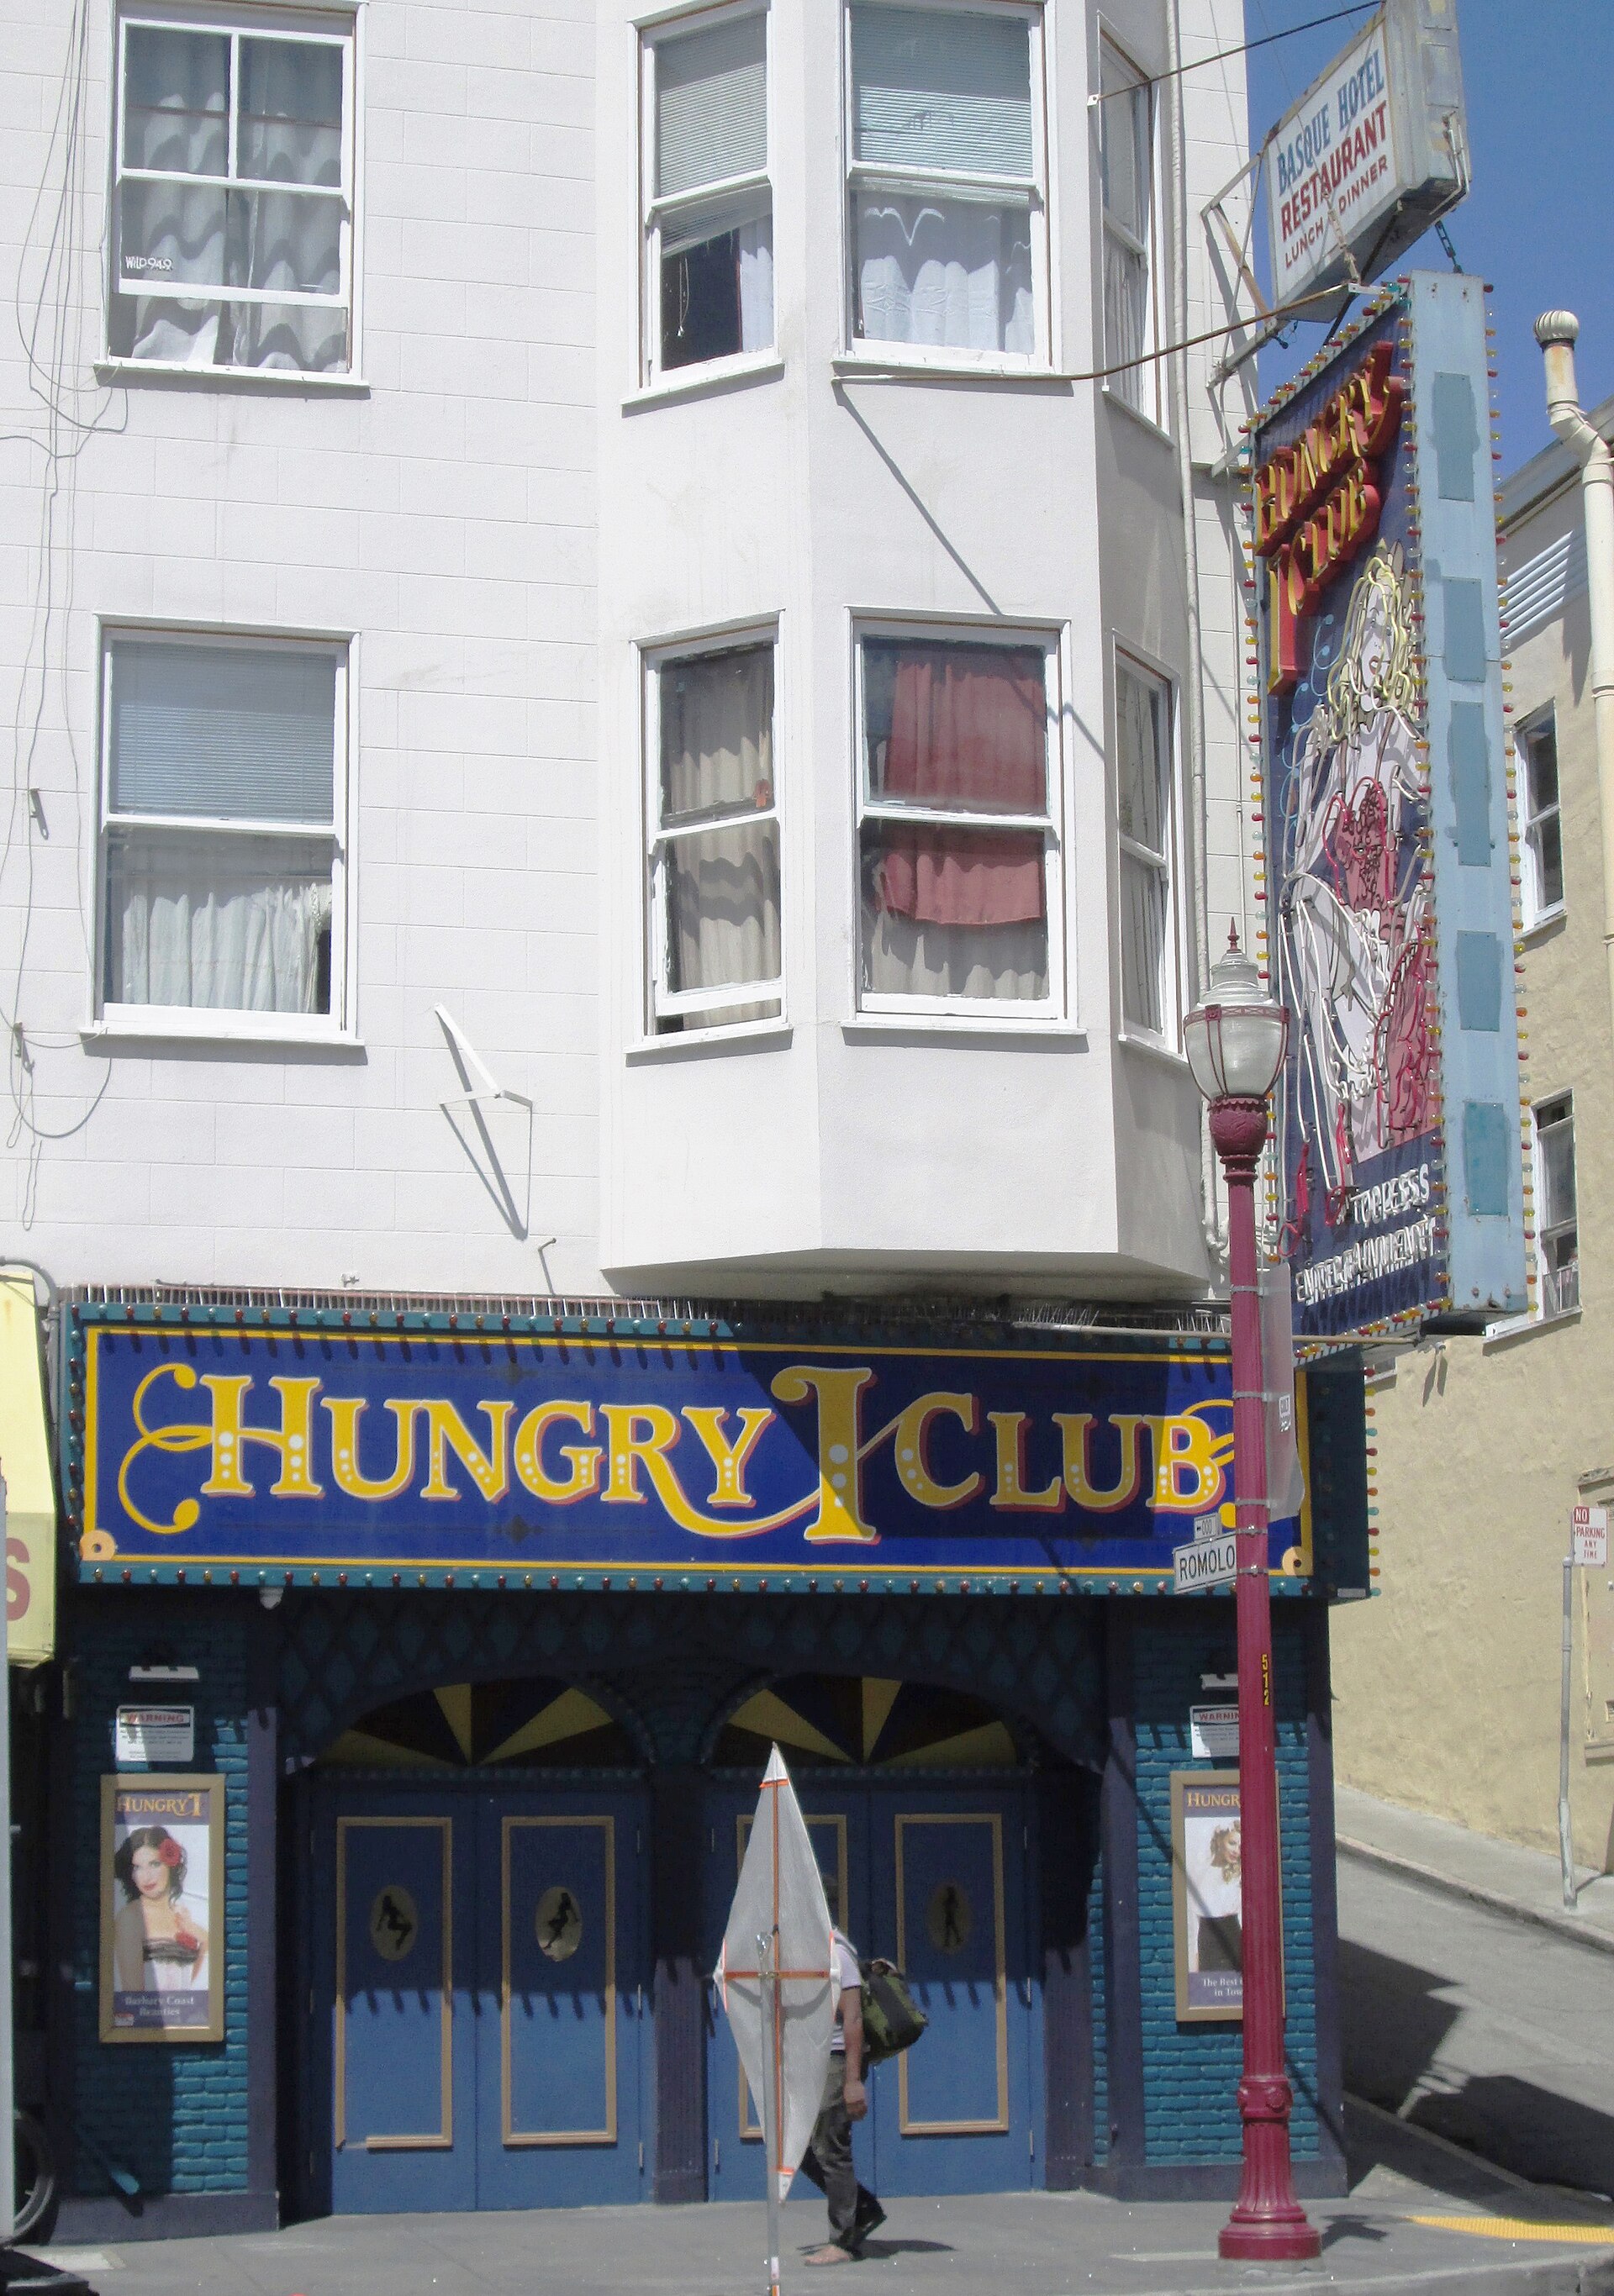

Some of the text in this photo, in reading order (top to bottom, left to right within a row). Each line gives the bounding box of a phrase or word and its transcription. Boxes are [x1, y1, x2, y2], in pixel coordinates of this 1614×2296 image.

[1276, 49, 1385, 197] BASQUE HOTEL
[1281, 99, 1387, 243] RESTAURANT
[1284, 154, 1388, 270] LUNCH DINNER
[1349, 1163, 1430, 1228] TOPLESS
[119, 1363, 1227, 1544] HUNGRY I CLUB
[1574, 1508, 1588, 1522] NO
[1576, 1526, 1605, 1539] PARKING
[1584, 1540, 1597, 1549] ANY
[1584, 1549, 1598, 1560] TIME
[1179, 1545, 1235, 1581] ROMOLO
[1262, 1653, 1270, 1706] 512
[128, 1714, 184, 1723] WARNING
[1199, 1711, 1240, 1721] WARNIN
[117, 1796, 188, 1817] HUNGRY
[1187, 1791, 1241, 1809] HUNGR
[1203, 1977, 1217, 1987] The
[1220, 1977, 1238, 1987] Best
[166, 1995, 194, 2005] Coast
[1215, 1988, 1223, 1997] in
